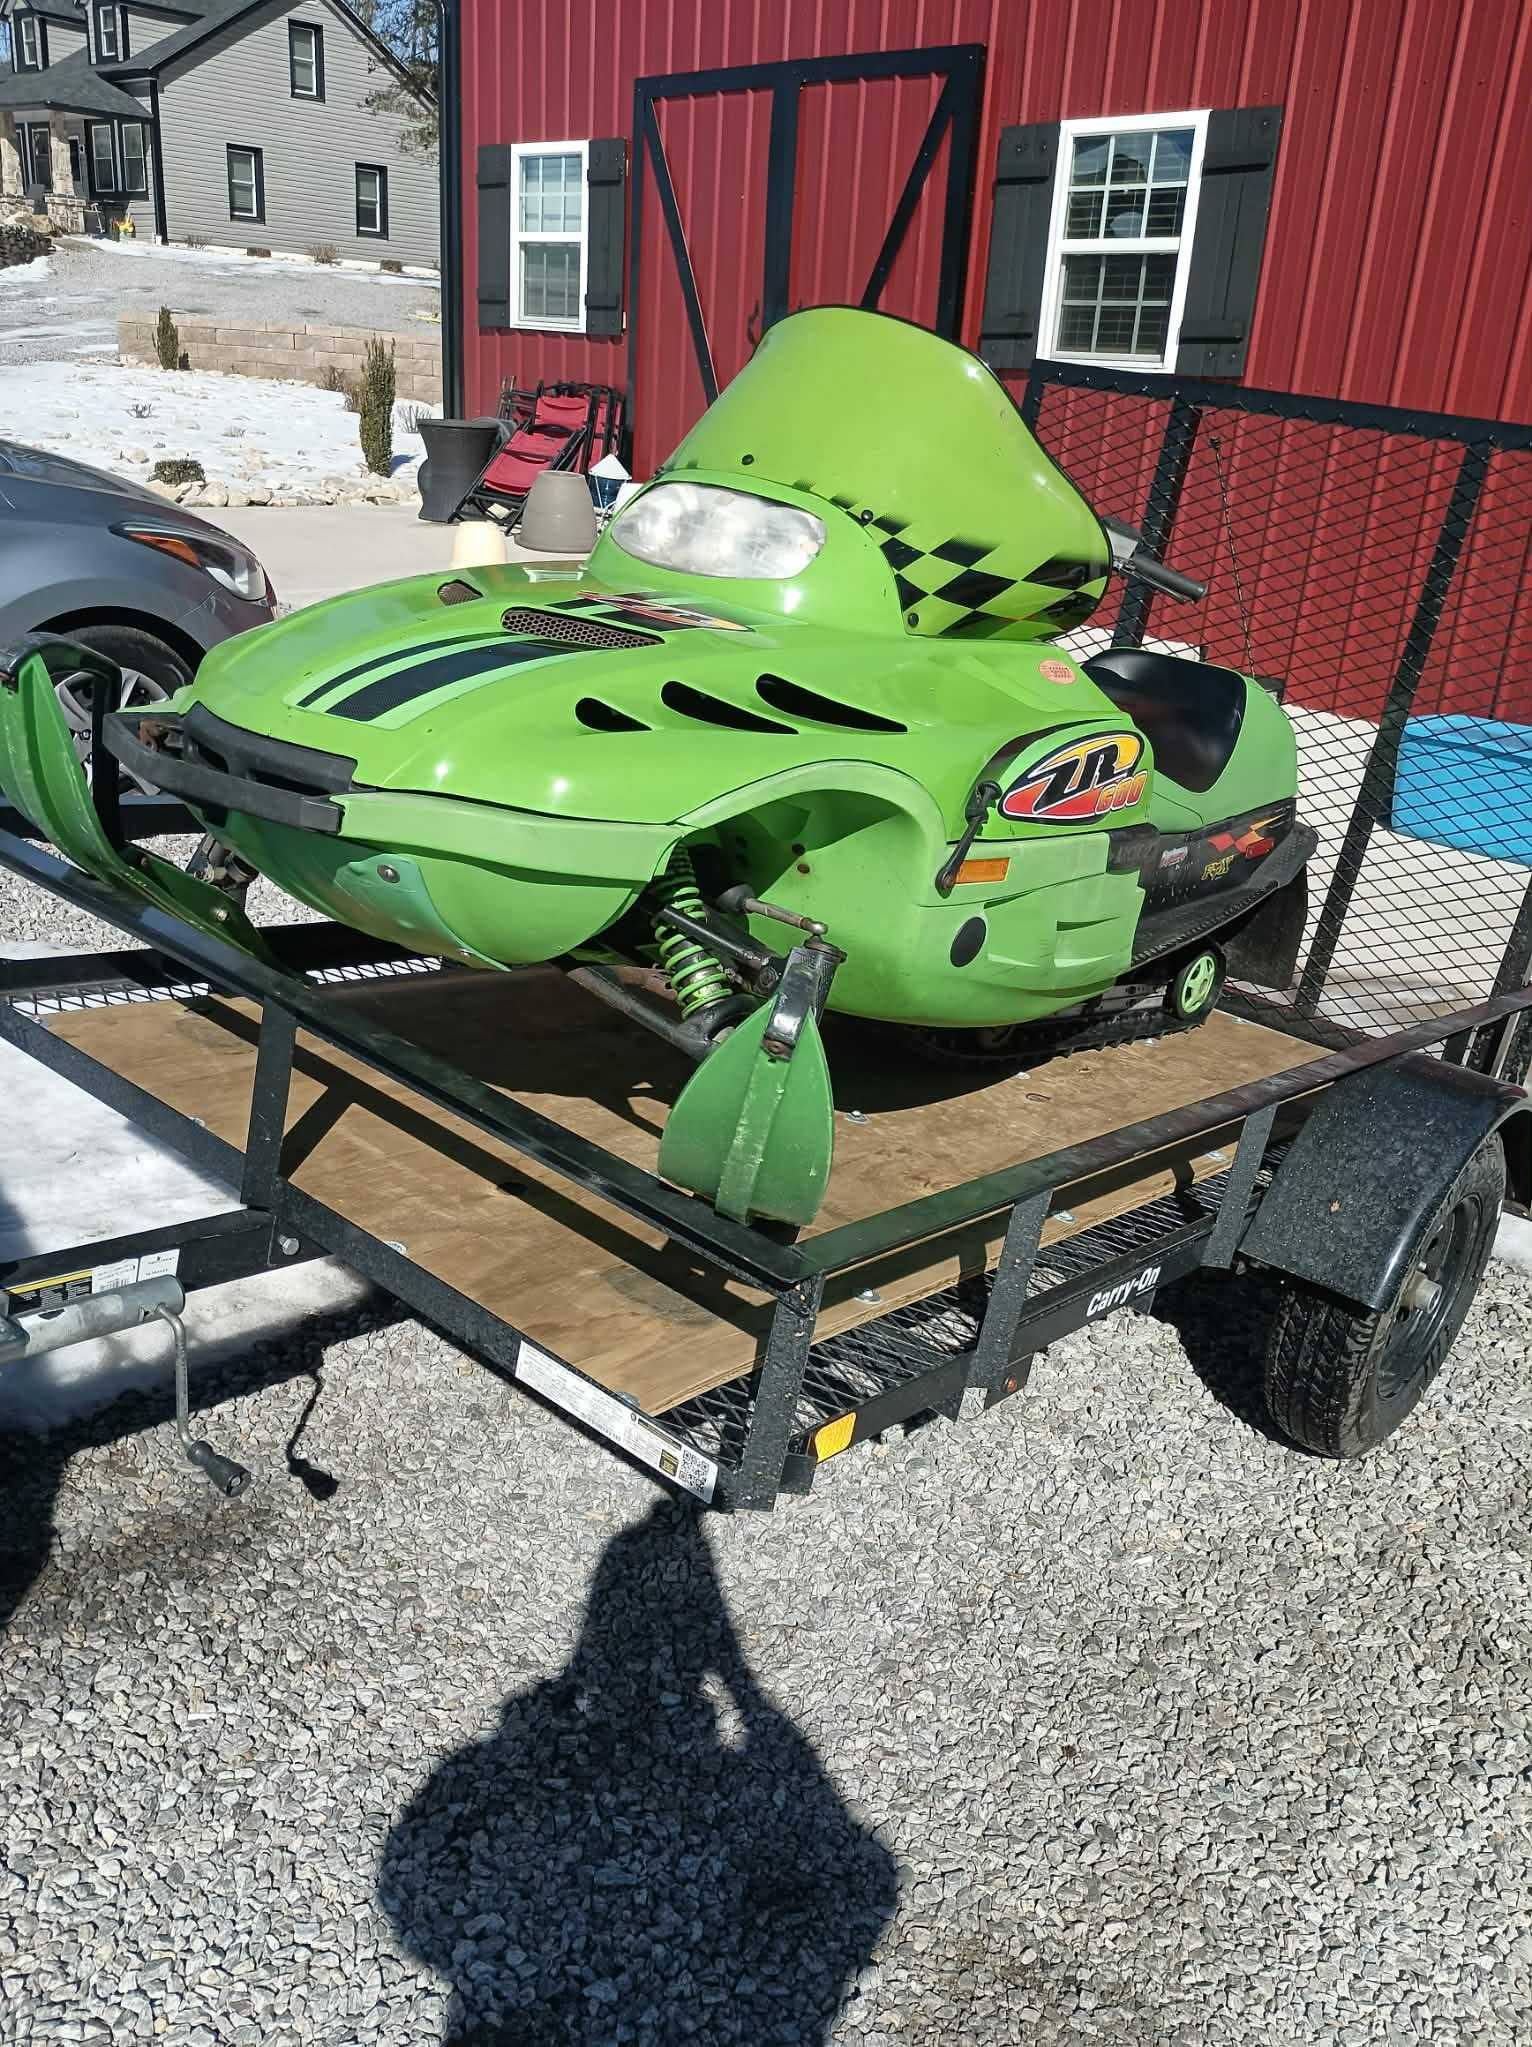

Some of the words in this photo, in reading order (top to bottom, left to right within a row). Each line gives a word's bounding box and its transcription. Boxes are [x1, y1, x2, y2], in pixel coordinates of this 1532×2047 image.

[1029, 742, 1128, 813] ZR
[1095, 770, 1148, 814] 600
[1087, 1266, 1161, 1317] Carry-On
